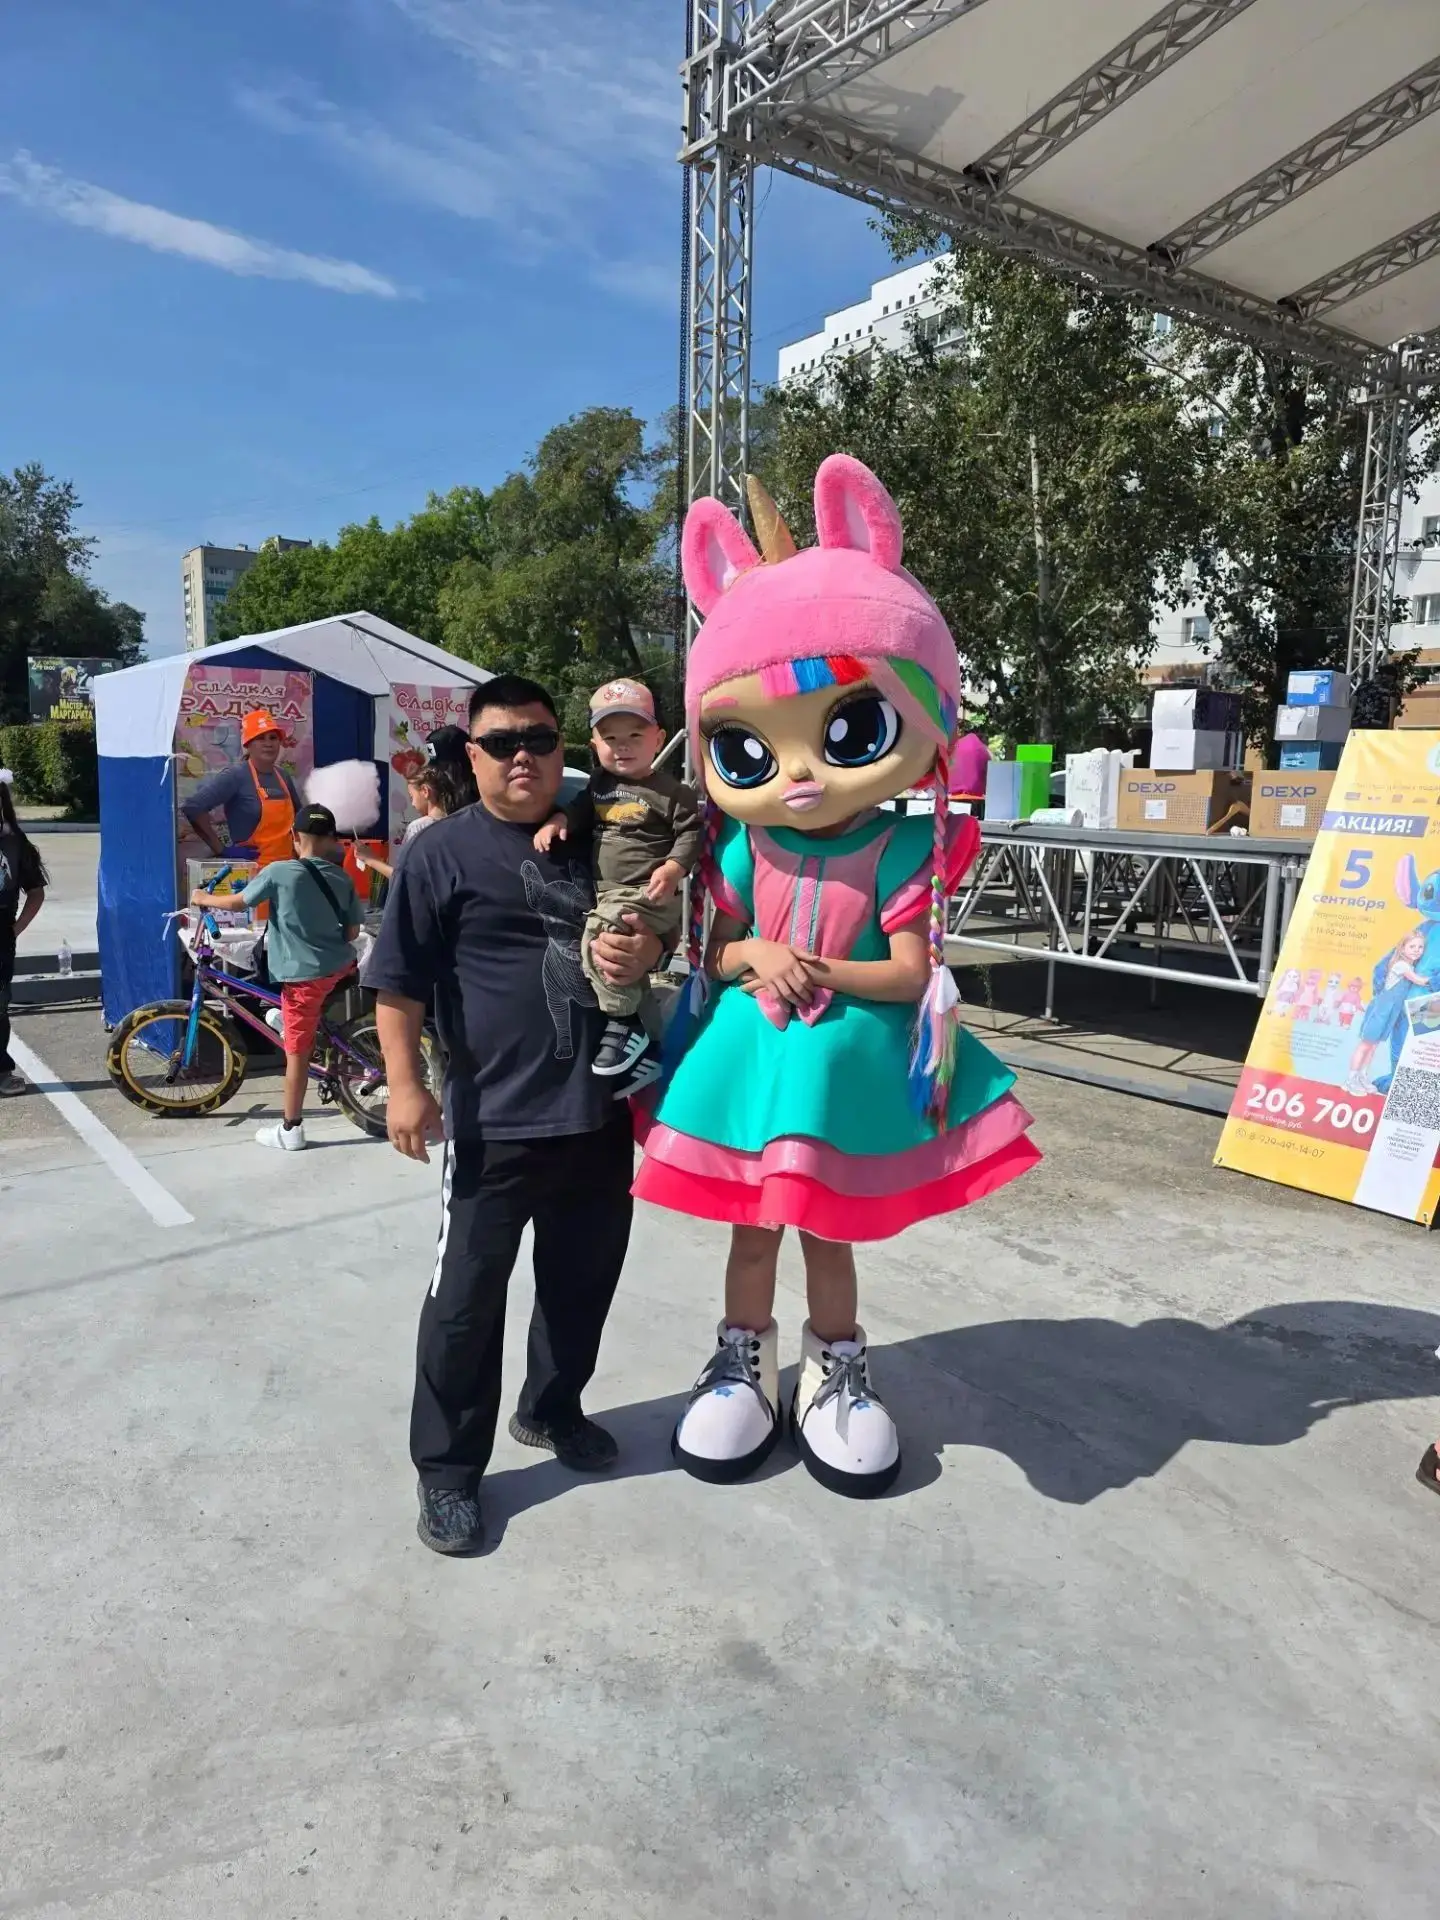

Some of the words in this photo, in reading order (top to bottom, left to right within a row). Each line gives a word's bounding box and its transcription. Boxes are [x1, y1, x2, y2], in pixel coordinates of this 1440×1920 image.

[195, 681, 286, 697] СЛАДКАЯ
[396, 690, 470, 718] Сладка
[1128, 782, 1176, 793] DEXP
[1261, 786, 1317, 798] DEXP
[1333, 815, 1414, 834] АКЦИЯ!
[1339, 849, 1373, 890] 5
[1312, 894, 1386, 911] сентября
[1246, 1083, 1305, 1118] 206
[1312, 1097, 1375, 1134] 700
